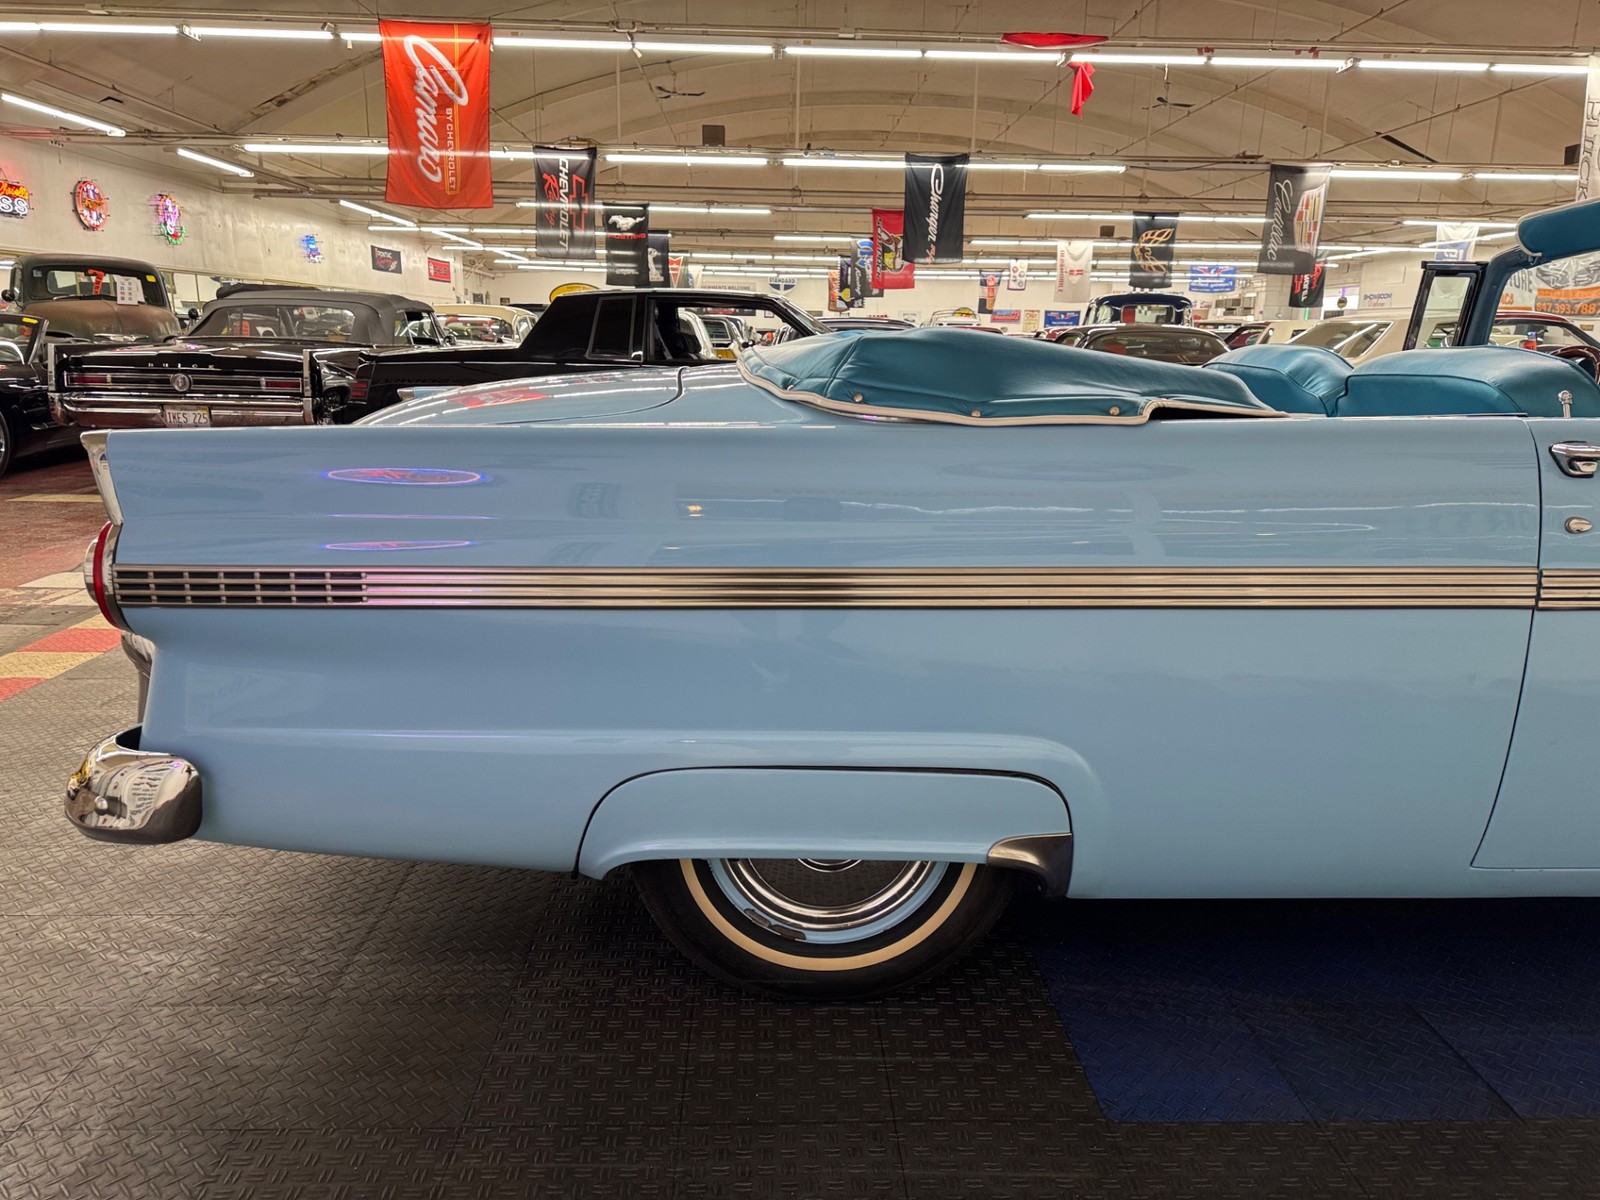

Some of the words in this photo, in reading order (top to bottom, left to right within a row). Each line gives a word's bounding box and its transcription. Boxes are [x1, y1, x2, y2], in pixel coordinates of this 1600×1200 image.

[403, 35, 469, 183] Camaro
[445, 108, 453, 122] BY
[446, 124, 456, 190] CHEVROLET
[0, 195, 28, 215] SS
[559, 158, 569, 251] CHEVROLET
[926, 163, 944, 242] Charger
[1267, 179, 1293, 261] Cadillac
[607, 232, 647, 240] MUSTANG
[769, 276, 796, 284] STANDARD
[192, 412, 208, 424] 225
